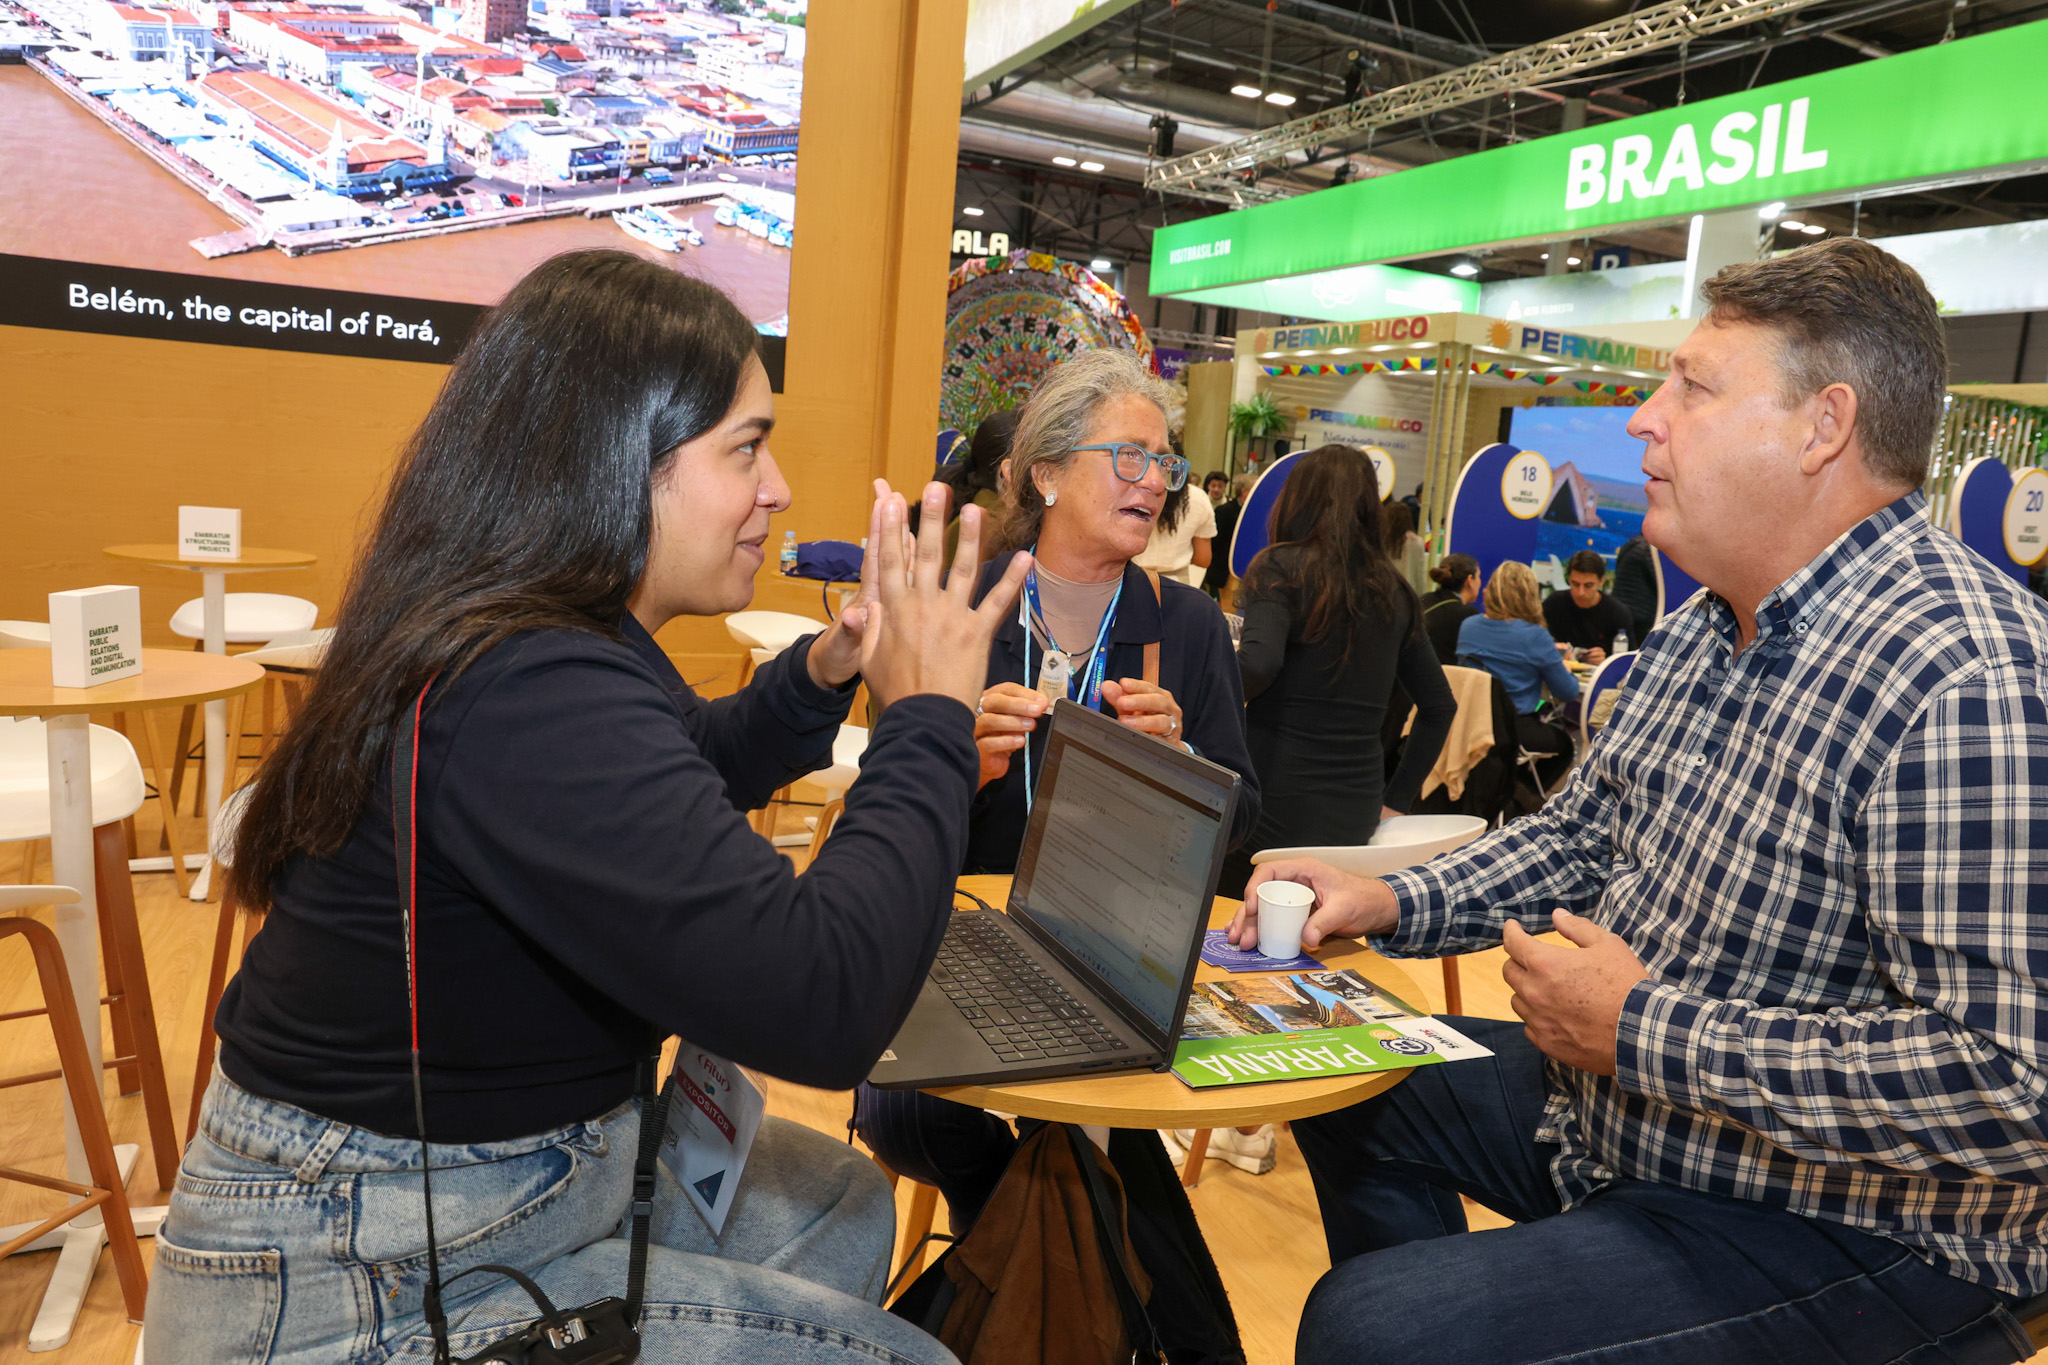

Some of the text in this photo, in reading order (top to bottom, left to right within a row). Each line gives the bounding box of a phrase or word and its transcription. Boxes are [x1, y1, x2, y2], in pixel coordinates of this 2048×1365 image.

[1565, 97, 1828, 210] BRASIL
[952, 229, 1009, 257] ALA
[1169, 239, 1232, 264] VISITBRASIL.COM
[68, 283, 441, 346] Belém, the capital of Pará,
[1273, 316, 1430, 349] PERNAMBUCO
[1310, 408, 1423, 433] PERNAMBUCO
[1521, 466, 1537, 482] 18
[1511, 496, 1539, 504] HORIZONTE
[2025, 490, 2044, 512] 20
[185, 538, 231, 546] STRUCTURING
[89, 625, 119, 637] EMBRATUR
[89, 636, 109, 647] PUBLIC
[90, 643, 119, 657] RELATIONS
[91, 652, 124, 666] AND DIGITAL
[91, 658, 136, 676] COMMUNICATION
[1188, 1043, 1378, 1082] PARANÁ
[682, 1078, 729, 1132] EXPOSITOR
